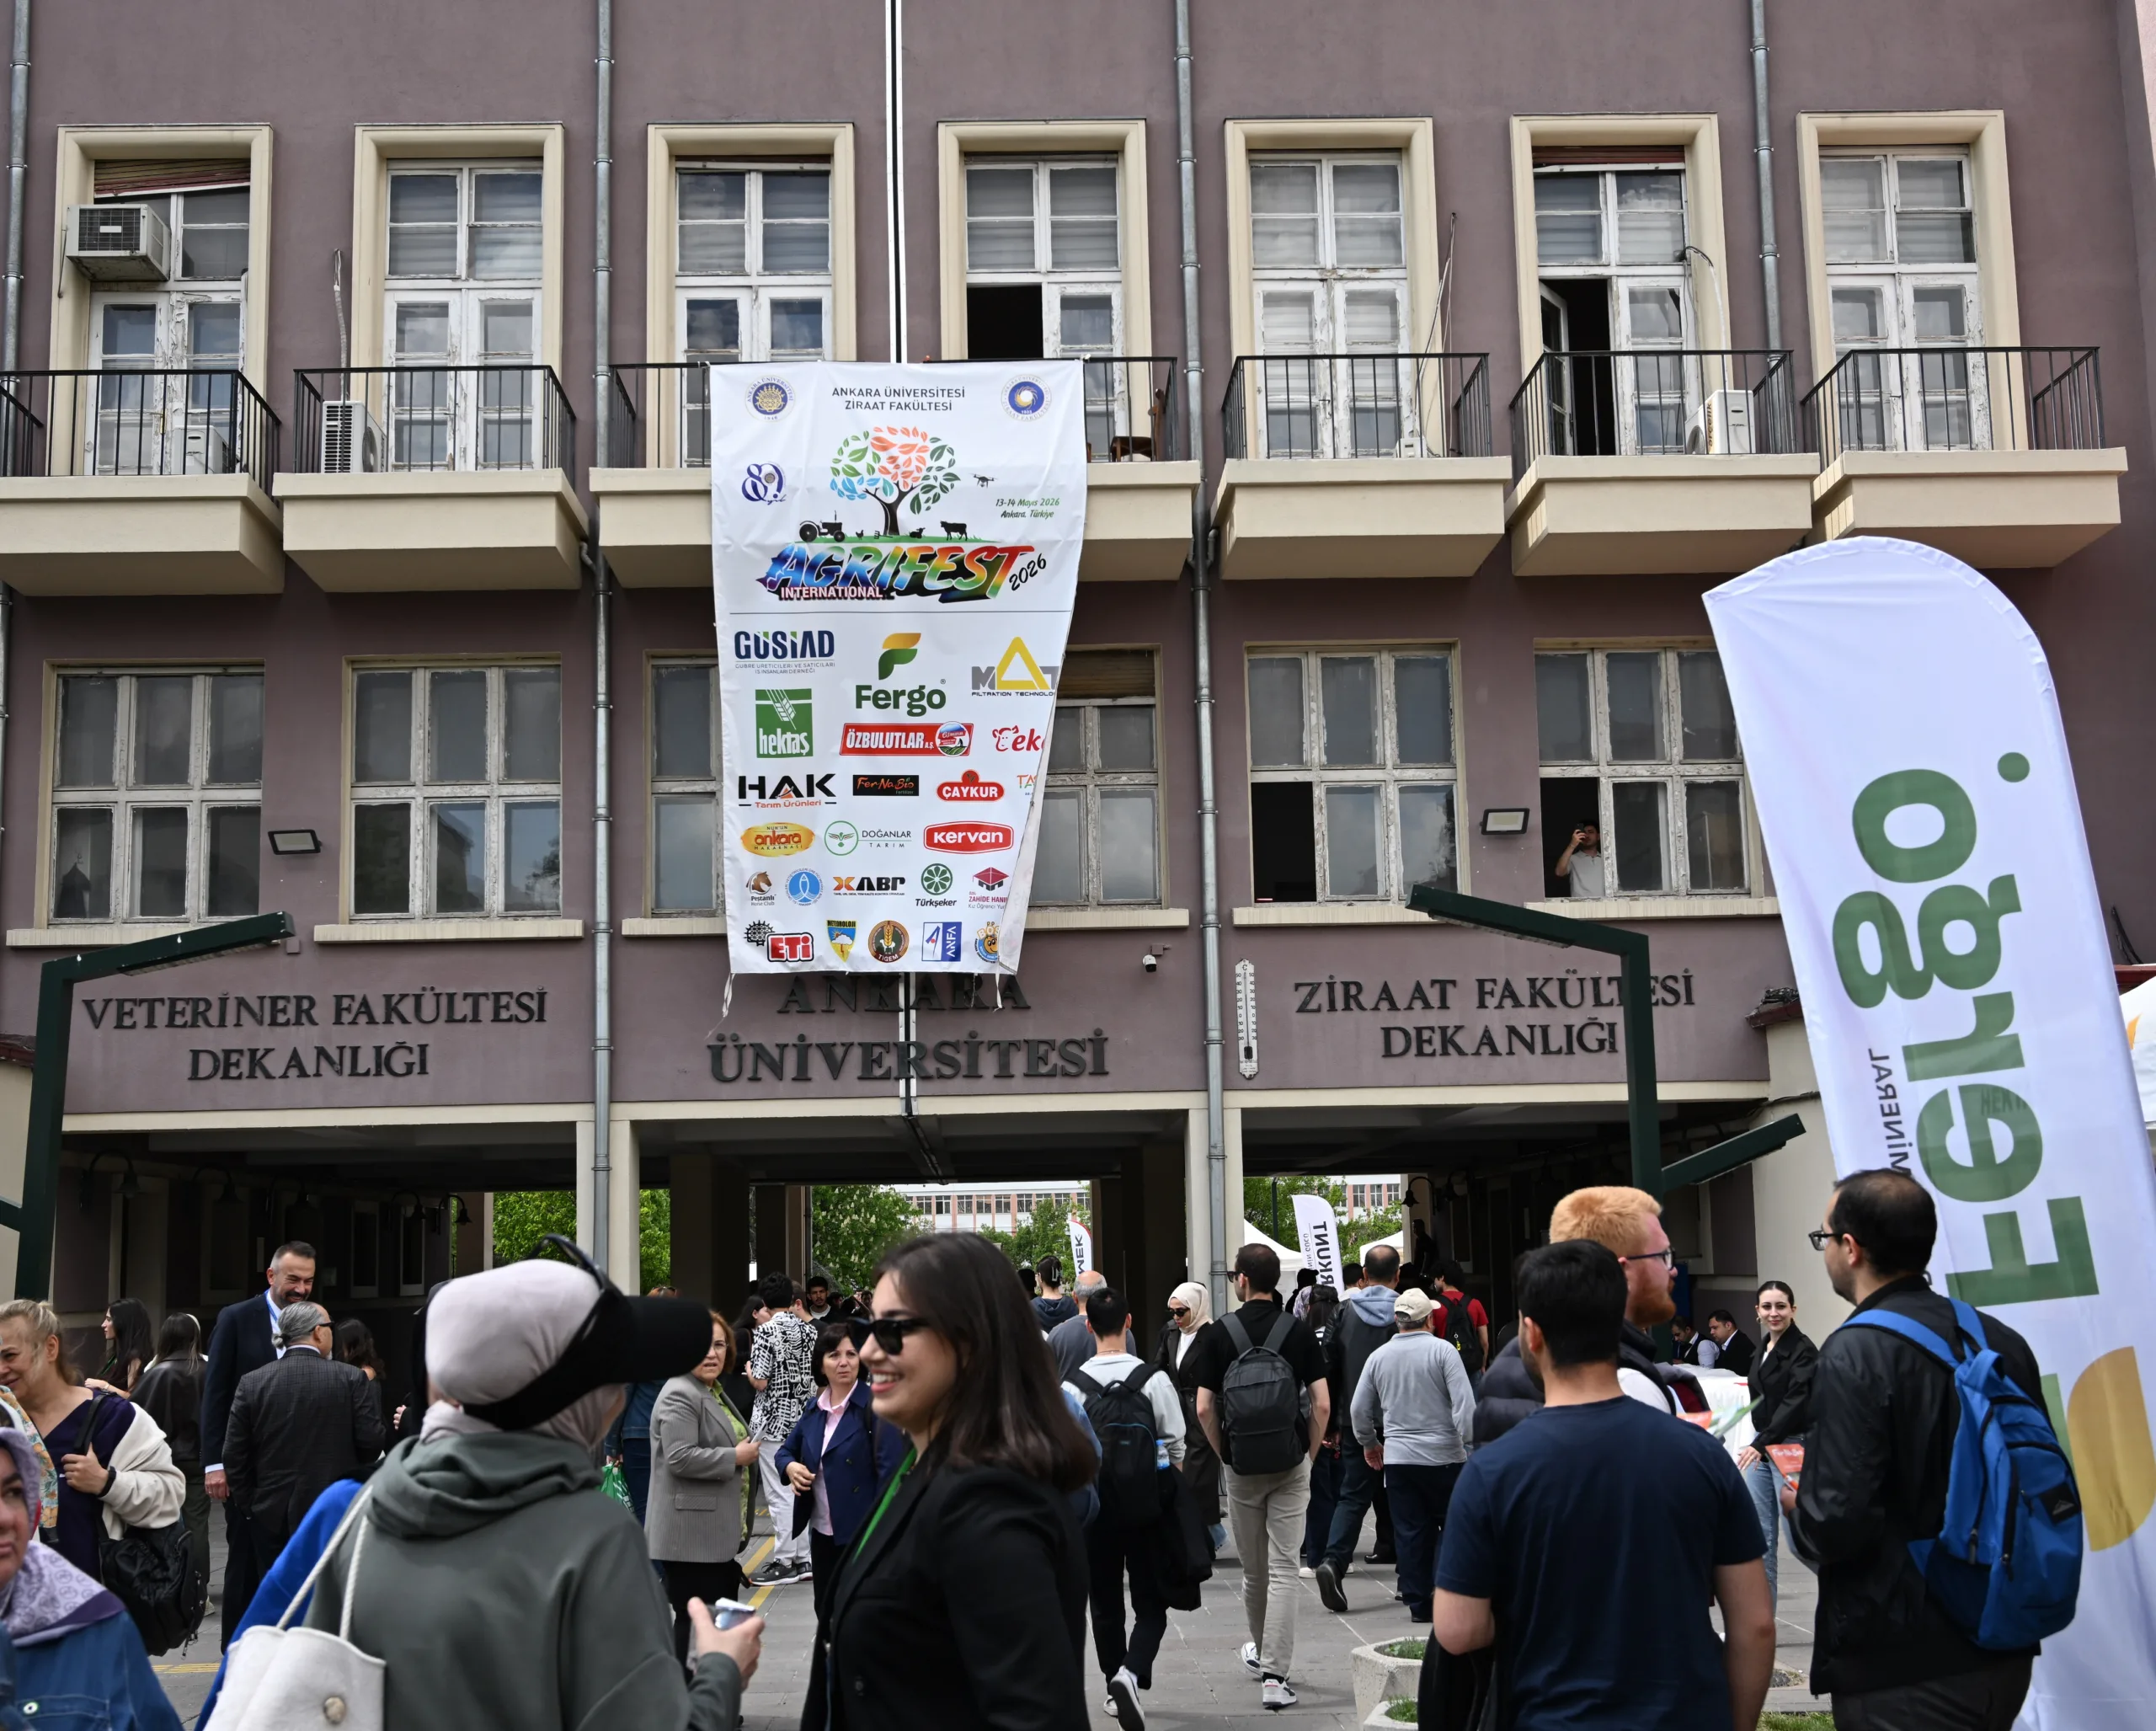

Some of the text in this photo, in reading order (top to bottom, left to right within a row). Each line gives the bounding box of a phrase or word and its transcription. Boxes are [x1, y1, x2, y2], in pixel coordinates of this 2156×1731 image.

[832, 386, 965, 398] ANKARA ÜNİVERSİTESİ
[845, 398, 953, 411] ZİRAAT FAKÜLTESİ
[1017, 499, 1038, 508] Mayıs
[1040, 498, 1060, 506] 2026
[1030, 510, 1054, 520] Türkiye
[762, 543, 1035, 601] AGRIFEST
[1009, 553, 1047, 591] 2026
[780, 585, 884, 601] INTERNATIONAL
[856, 685, 947, 717] Fergo
[759, 728, 810, 756] hektaş
[846, 729, 925, 749] ÖZBULUTLAR
[738, 773, 836, 799] HAK
[942, 786, 998, 799] ÇAYKUR
[783, 799, 821, 808] Ürünleri
[755, 830, 801, 846] ankara
[862, 829, 911, 838] DOĞANLAR
[915, 898, 957, 907] Türkşeker
[947, 926, 957, 958] ANFA
[776, 974, 1031, 1013] ANKARA
[1294, 974, 1457, 1013] ZİRAAT
[83, 985, 547, 1029] VETERİNER FAKÜLTESİ
[1380, 1014, 1619, 1058] DEKANLIĞI
[187, 1040, 430, 1081] DEKANLIĞI
[707, 1027, 1110, 1082] ÜNİVERSİTESİ
